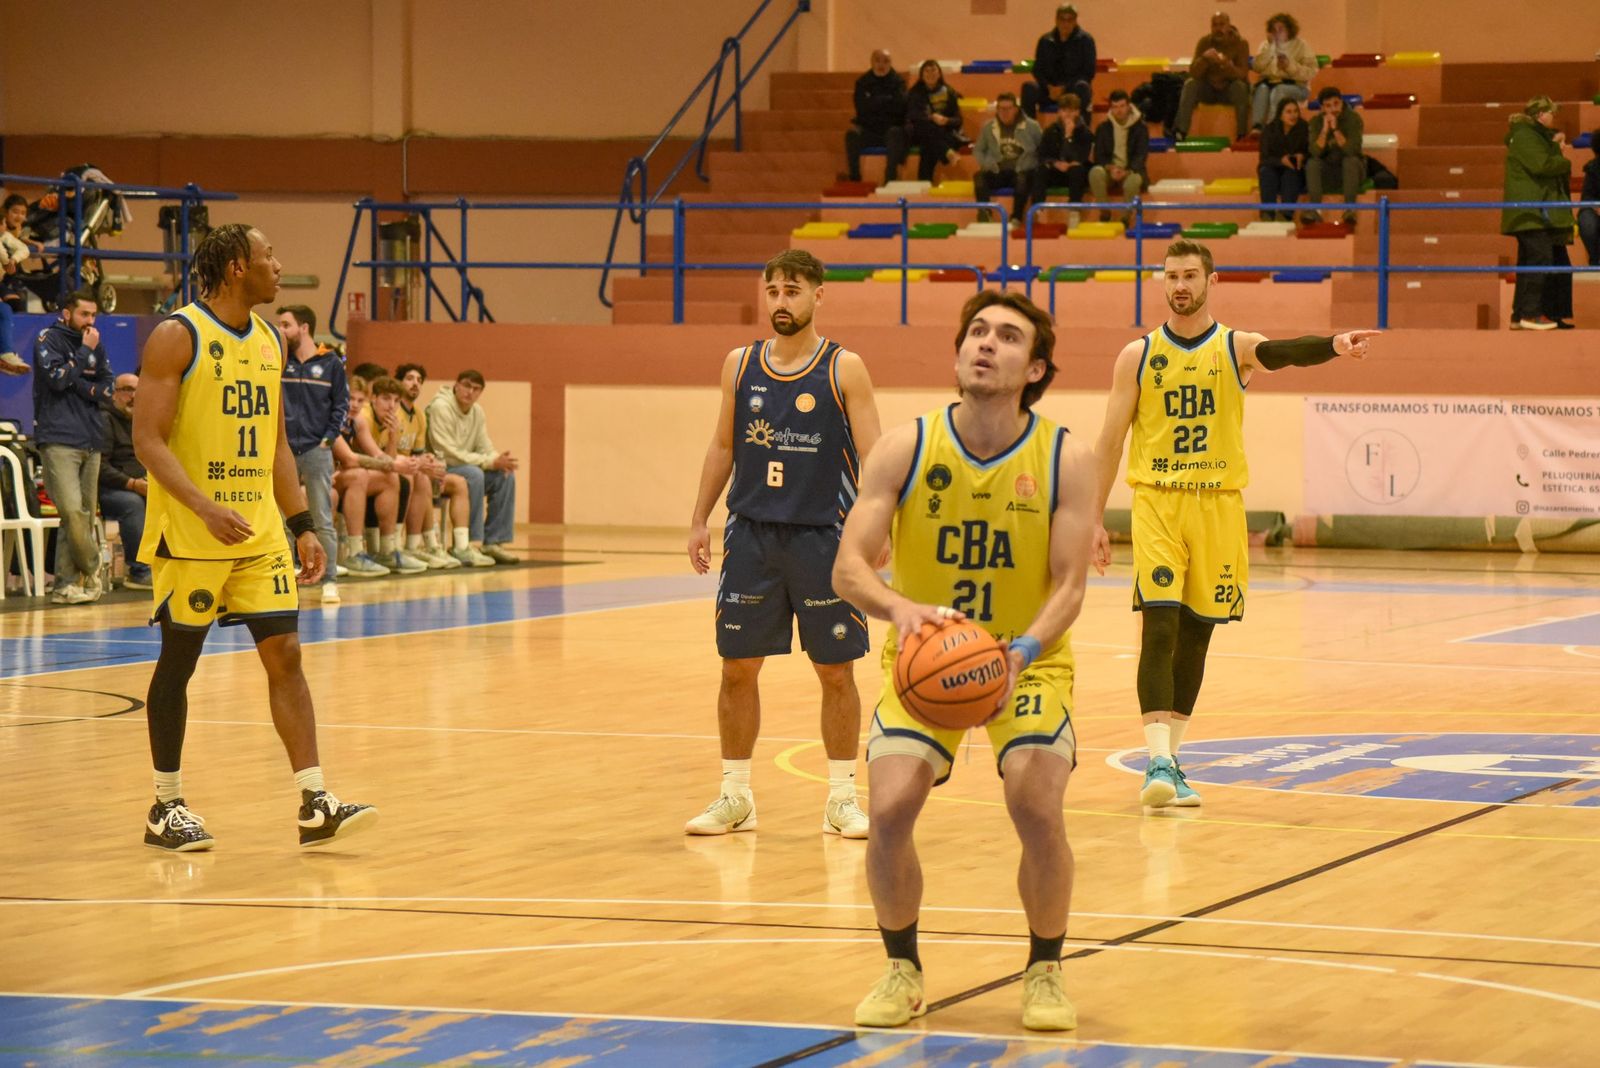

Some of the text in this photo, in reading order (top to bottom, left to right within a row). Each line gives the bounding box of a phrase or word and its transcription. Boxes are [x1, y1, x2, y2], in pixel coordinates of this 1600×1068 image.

[222, 380, 270, 418] CBA
[1164, 384, 1216, 419] CBA
[1315, 402, 1429, 414] TRANSFORMAMOS
[1434, 404, 1449, 414] TU
[1452, 404, 1507, 416] IMAGEN,
[1511, 404, 1593, 417] RENOVAMOS
[237, 425, 258, 457] 11
[1173, 425, 1208, 454] 22
[1171, 460, 1227, 471] damex.io
[1542, 449, 1600, 459] Calle Pedrer
[766, 461, 784, 488] 6
[214, 491, 263, 502] ALGECI
[936, 520, 1015, 570] CBA
[273, 574, 290, 594] 11
[1215, 585, 1234, 603] 22
[952, 580, 992, 622] 21
[940, 658, 1005, 690] Wilson
[1015, 694, 1042, 717] 21
